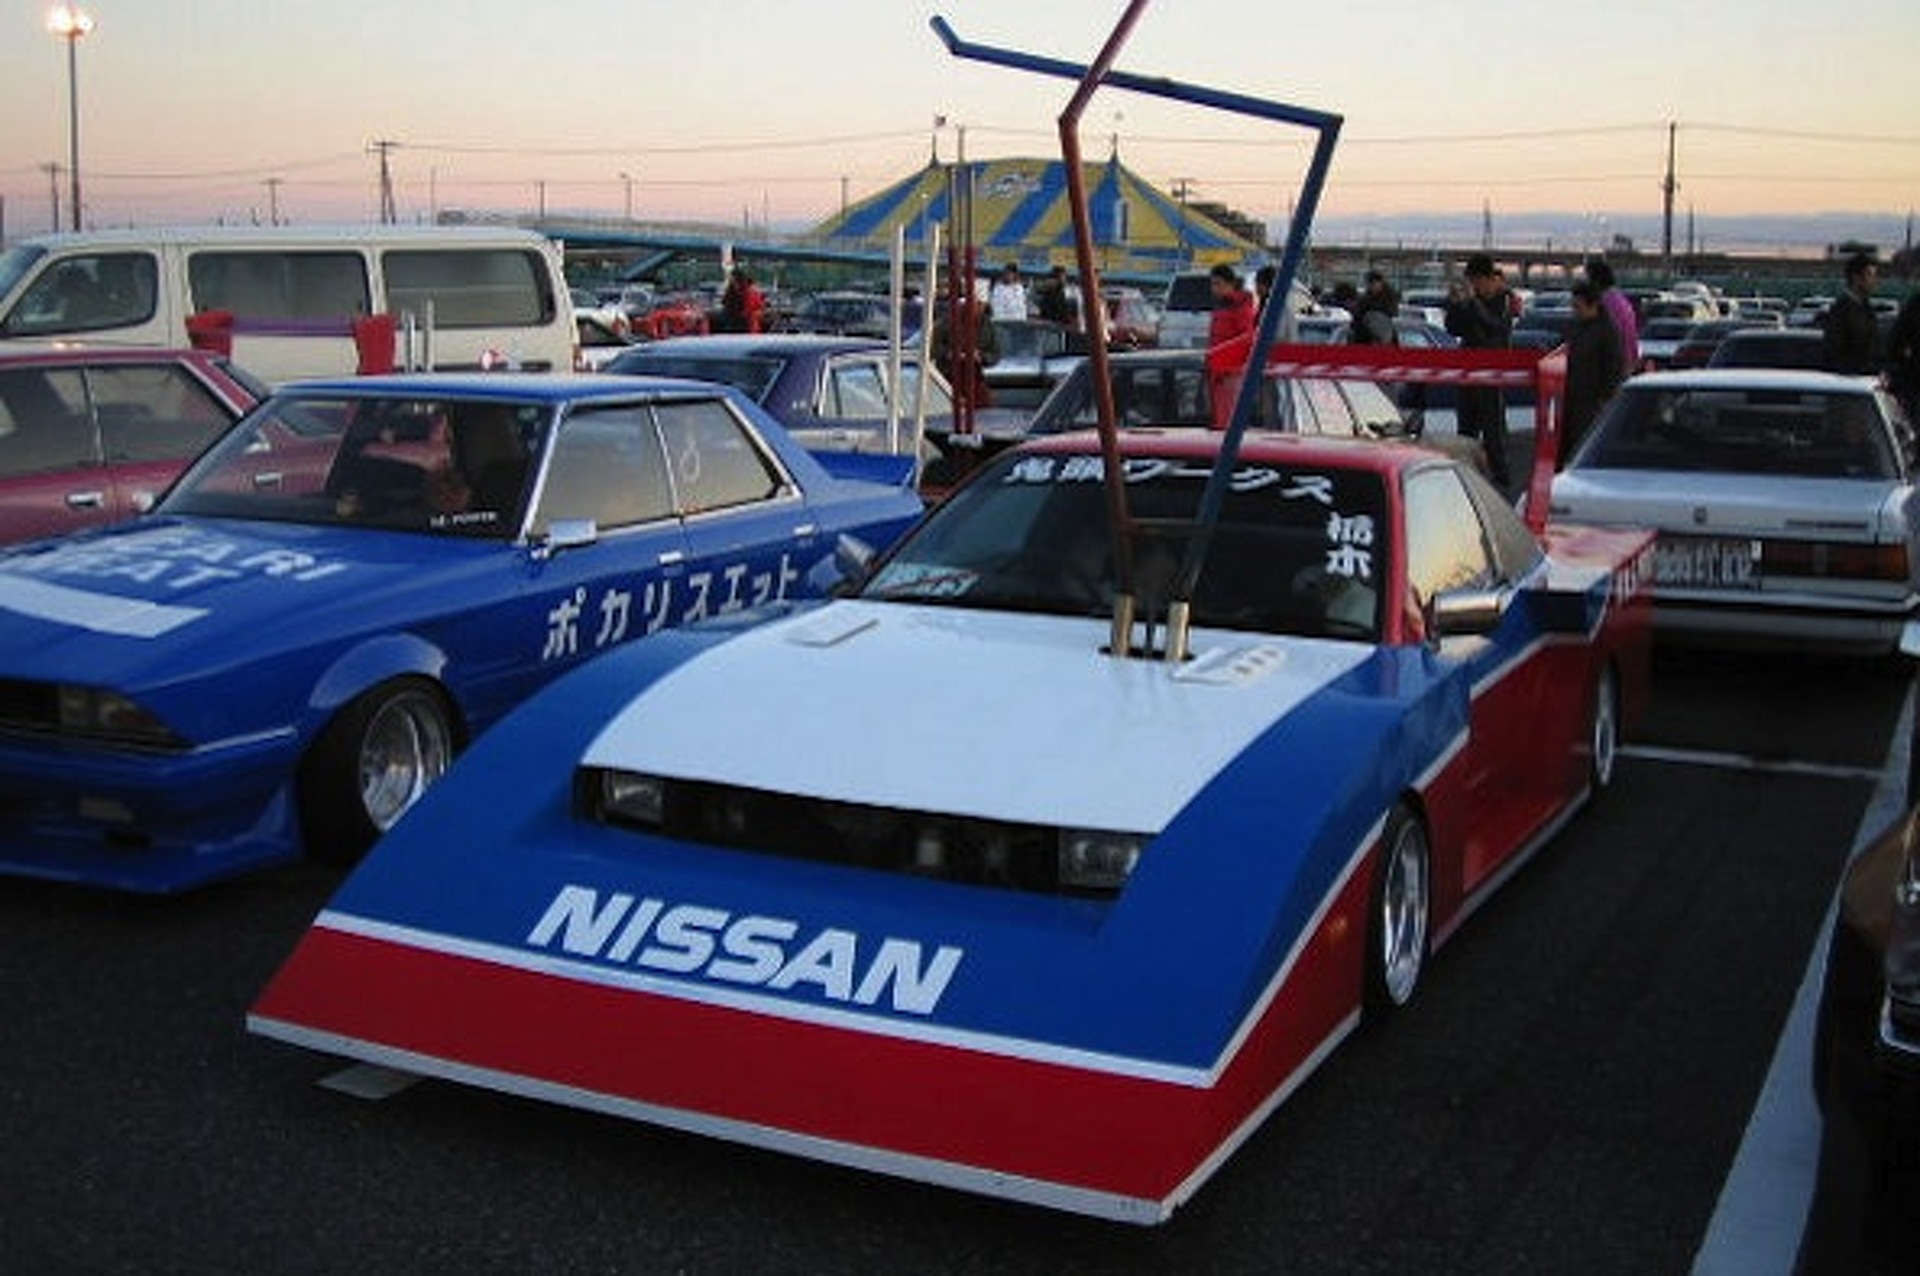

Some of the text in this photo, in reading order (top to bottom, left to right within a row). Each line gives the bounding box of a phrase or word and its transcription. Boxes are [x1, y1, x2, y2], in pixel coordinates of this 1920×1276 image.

[543, 553, 799, 661] ポカリスエット
[527, 884, 964, 1015] NISSAN
